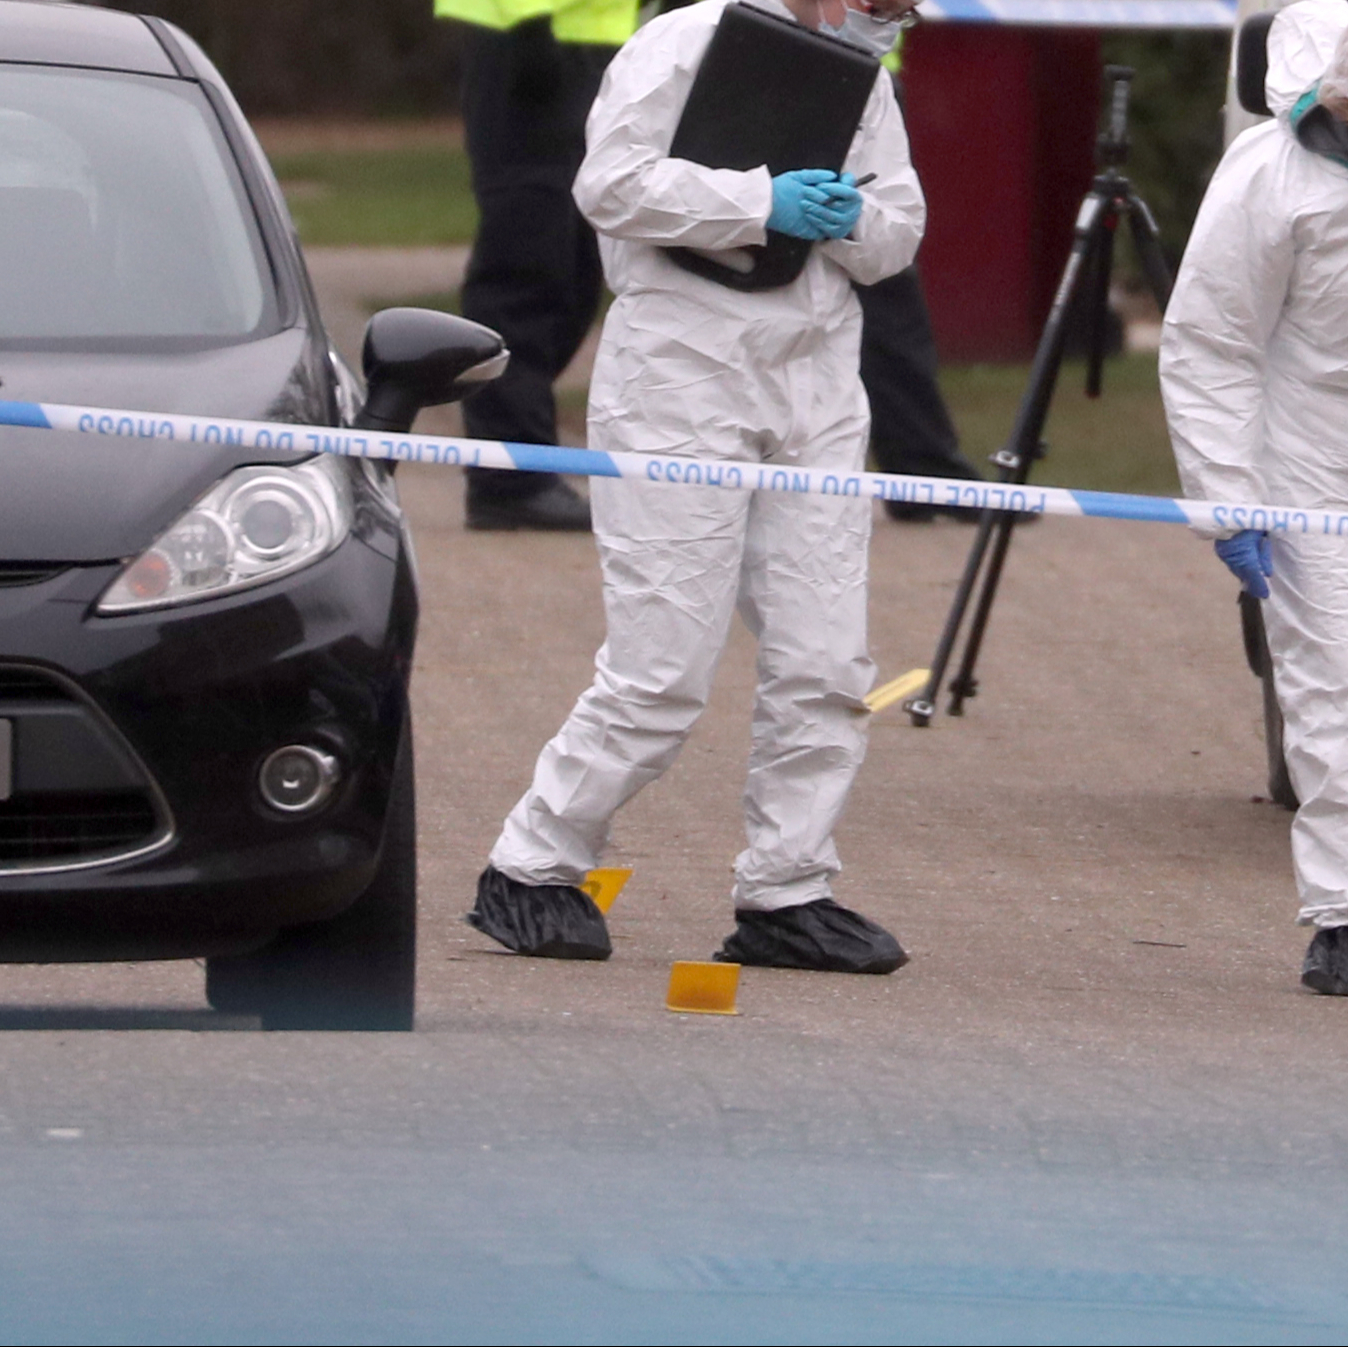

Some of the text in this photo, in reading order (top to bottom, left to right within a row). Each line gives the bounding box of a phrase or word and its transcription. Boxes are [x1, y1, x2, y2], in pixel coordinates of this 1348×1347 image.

[645, 460, 1046, 513] POLICE LINE DO NOT CROSS
[1211, 505, 1309, 534] CROSS
